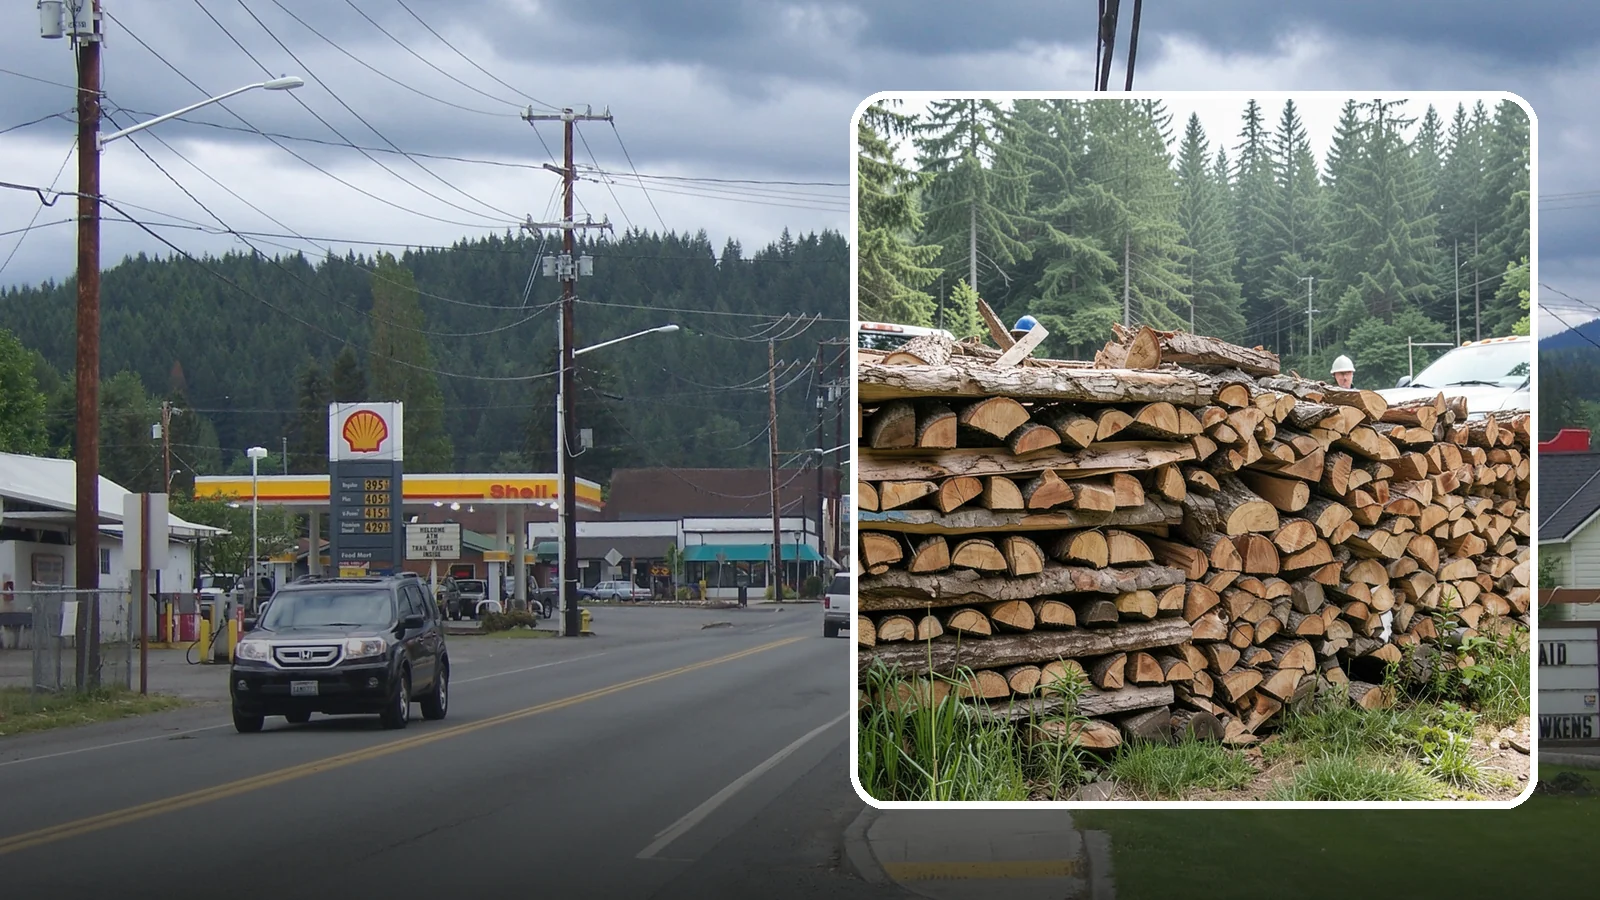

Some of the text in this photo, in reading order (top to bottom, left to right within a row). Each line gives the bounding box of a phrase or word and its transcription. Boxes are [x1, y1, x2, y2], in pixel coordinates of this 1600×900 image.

[366, 480, 383, 490] 395
[490, 484, 547, 498] Shell
[366, 494, 383, 504] 405
[366, 508, 383, 518] 415
[366, 522, 383, 532] 429
[1539, 643, 1567, 666] AID
